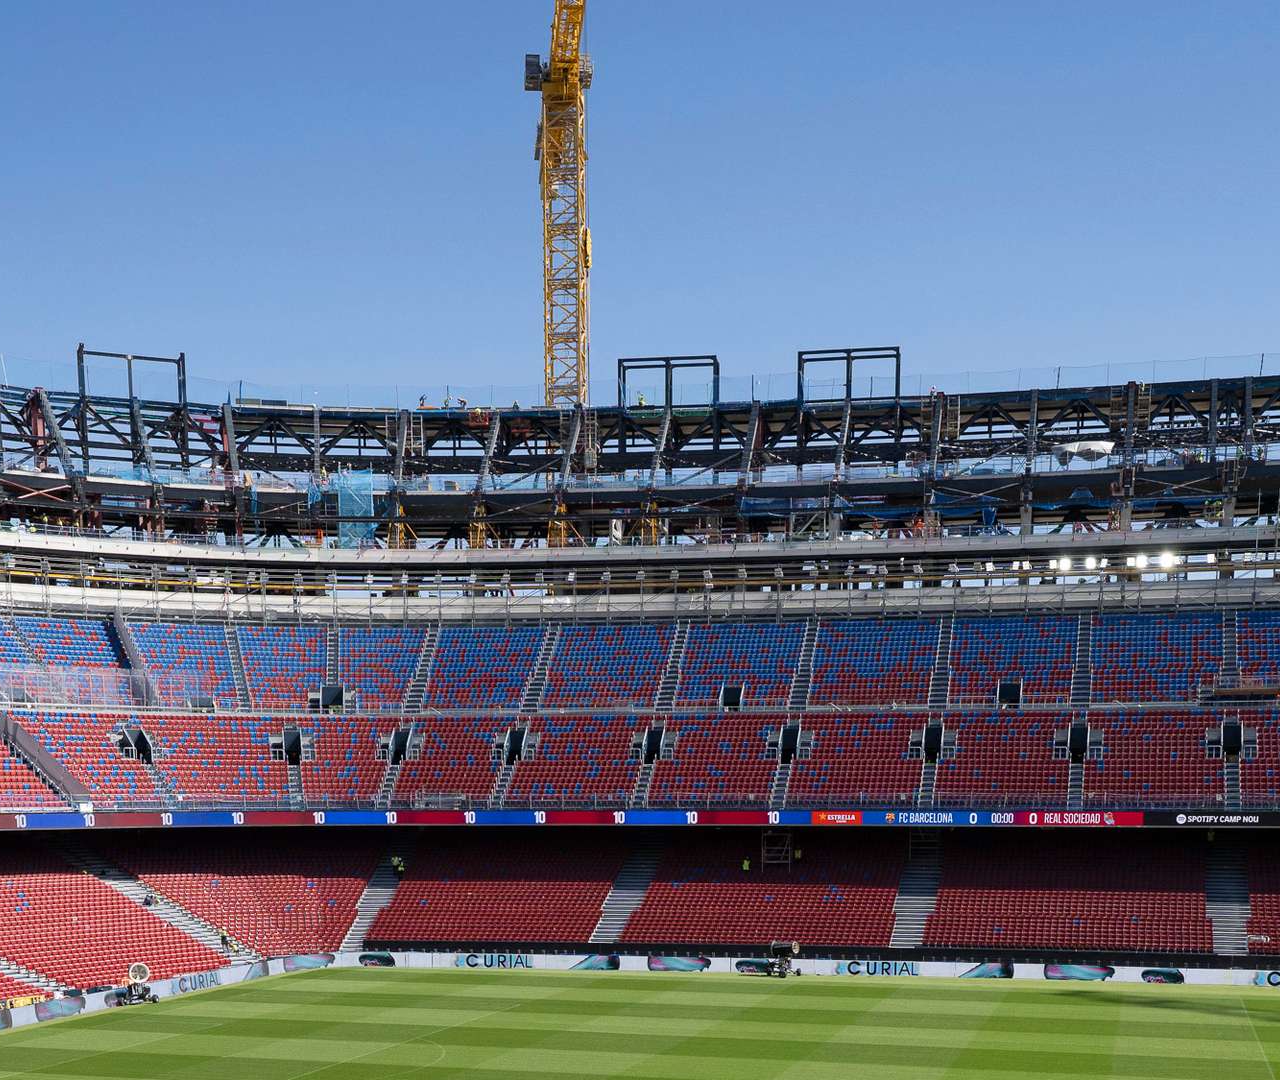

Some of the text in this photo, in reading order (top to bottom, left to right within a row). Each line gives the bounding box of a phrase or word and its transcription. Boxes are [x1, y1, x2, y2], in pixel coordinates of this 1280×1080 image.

[14, 814, 27, 828] 10
[83, 813, 95, 827] 10
[160, 812, 173, 826] 10
[231, 811, 244, 825] 10
[312, 811, 325, 825] 10
[385, 811, 397, 825] 10
[463, 811, 476, 824] 10
[534, 810, 546, 824] 10
[613, 811, 625, 824] 10
[686, 811, 698, 824] 10
[767, 811, 780, 824] 10
[898, 812, 1101, 825] FC BARCELONA 0 00:00 0 REAL SOCIEDAD
[1187, 815, 1259, 824] SPOTIFY CAMP NOU
[466, 954, 533, 969] CURIAL
[847, 961, 919, 976] CURIAL
[178, 972, 221, 993] CURIAL
